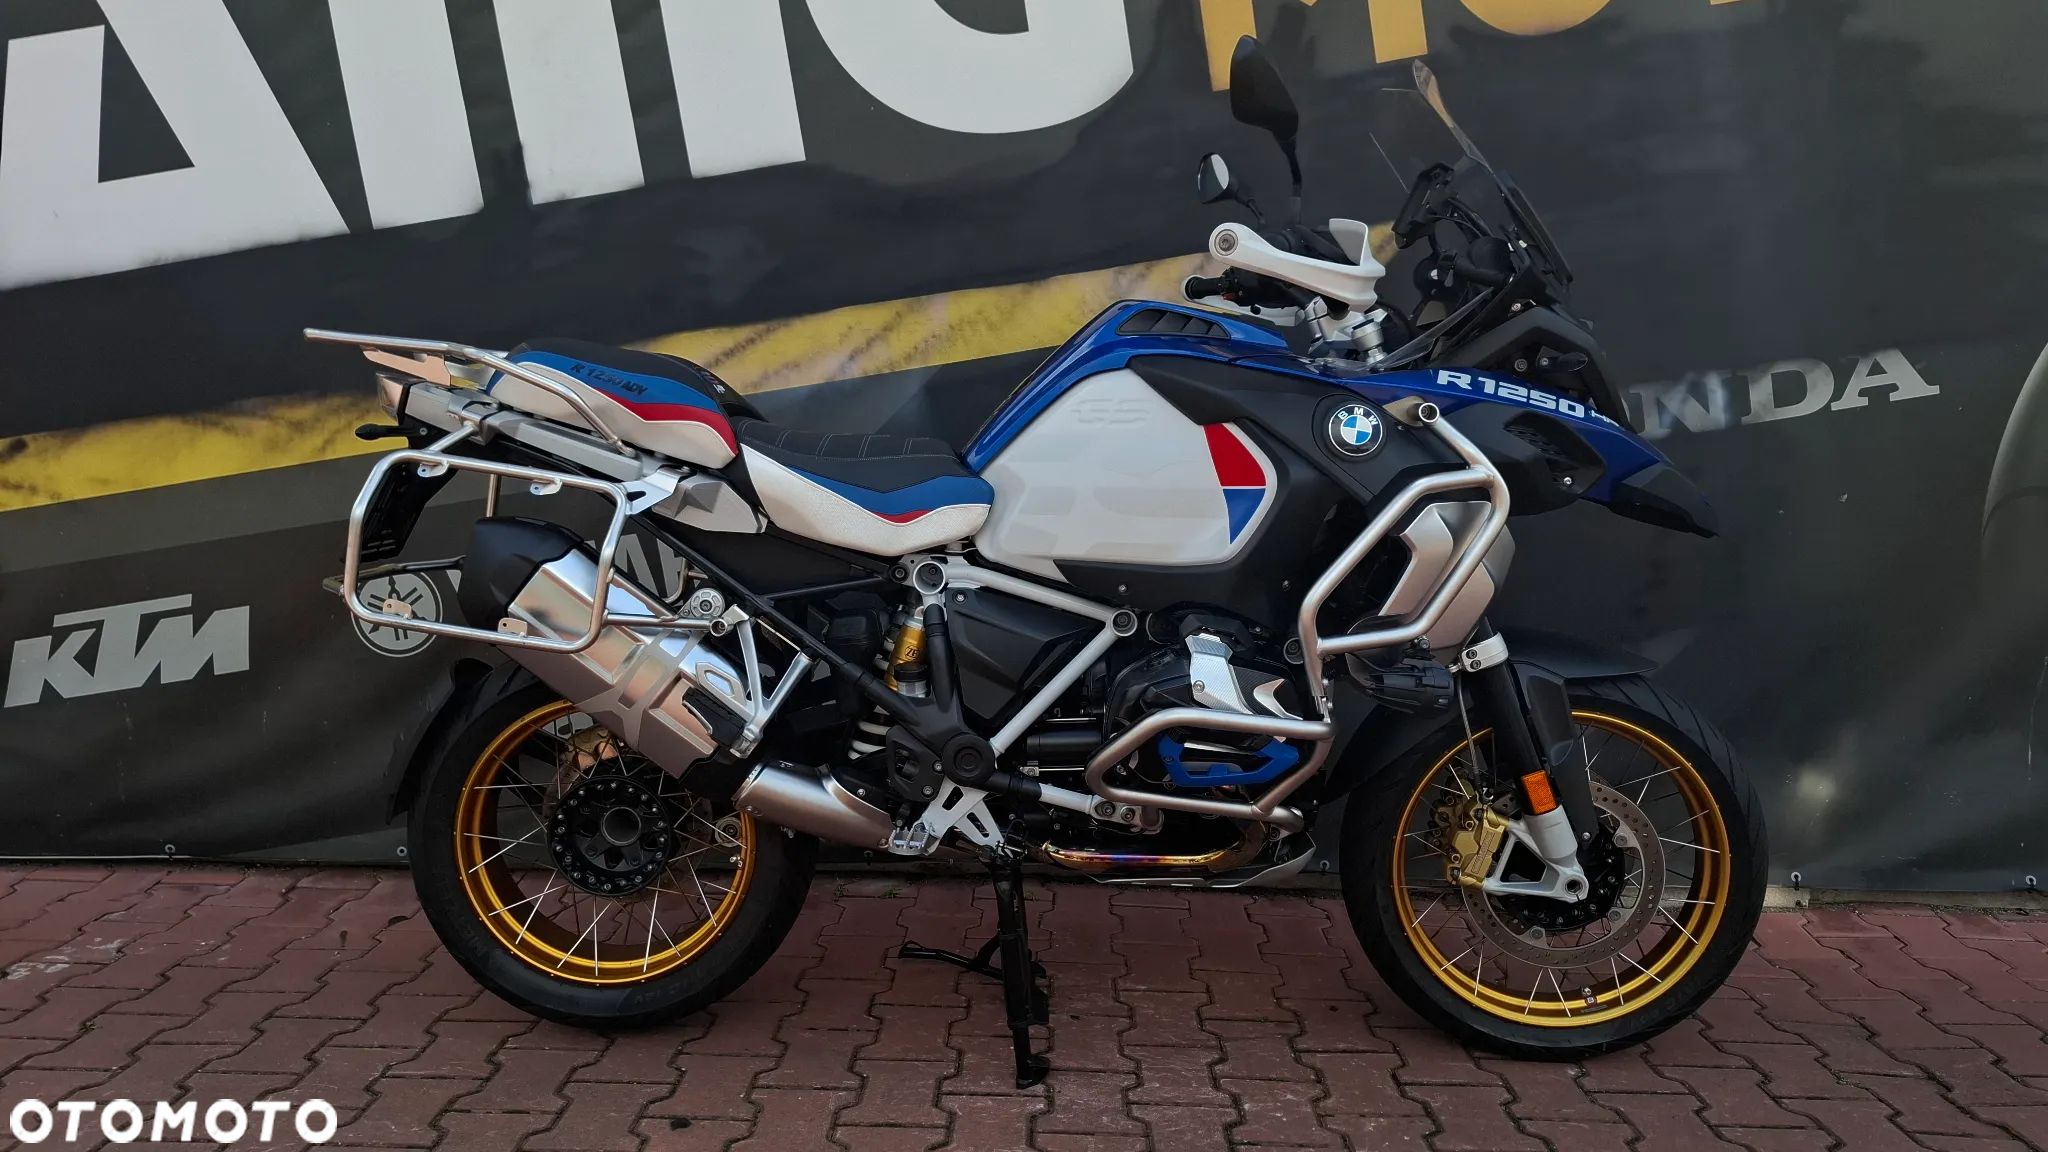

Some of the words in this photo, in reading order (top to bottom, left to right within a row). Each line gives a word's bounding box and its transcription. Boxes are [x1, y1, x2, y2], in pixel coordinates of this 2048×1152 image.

[1337, 406, 1379, 426] BMW
[1436, 369, 1472, 390] R
[1477, 376, 1585, 418] 1250
[1620, 348, 1941, 439] NDA
[3, 593, 250, 709] KTM
